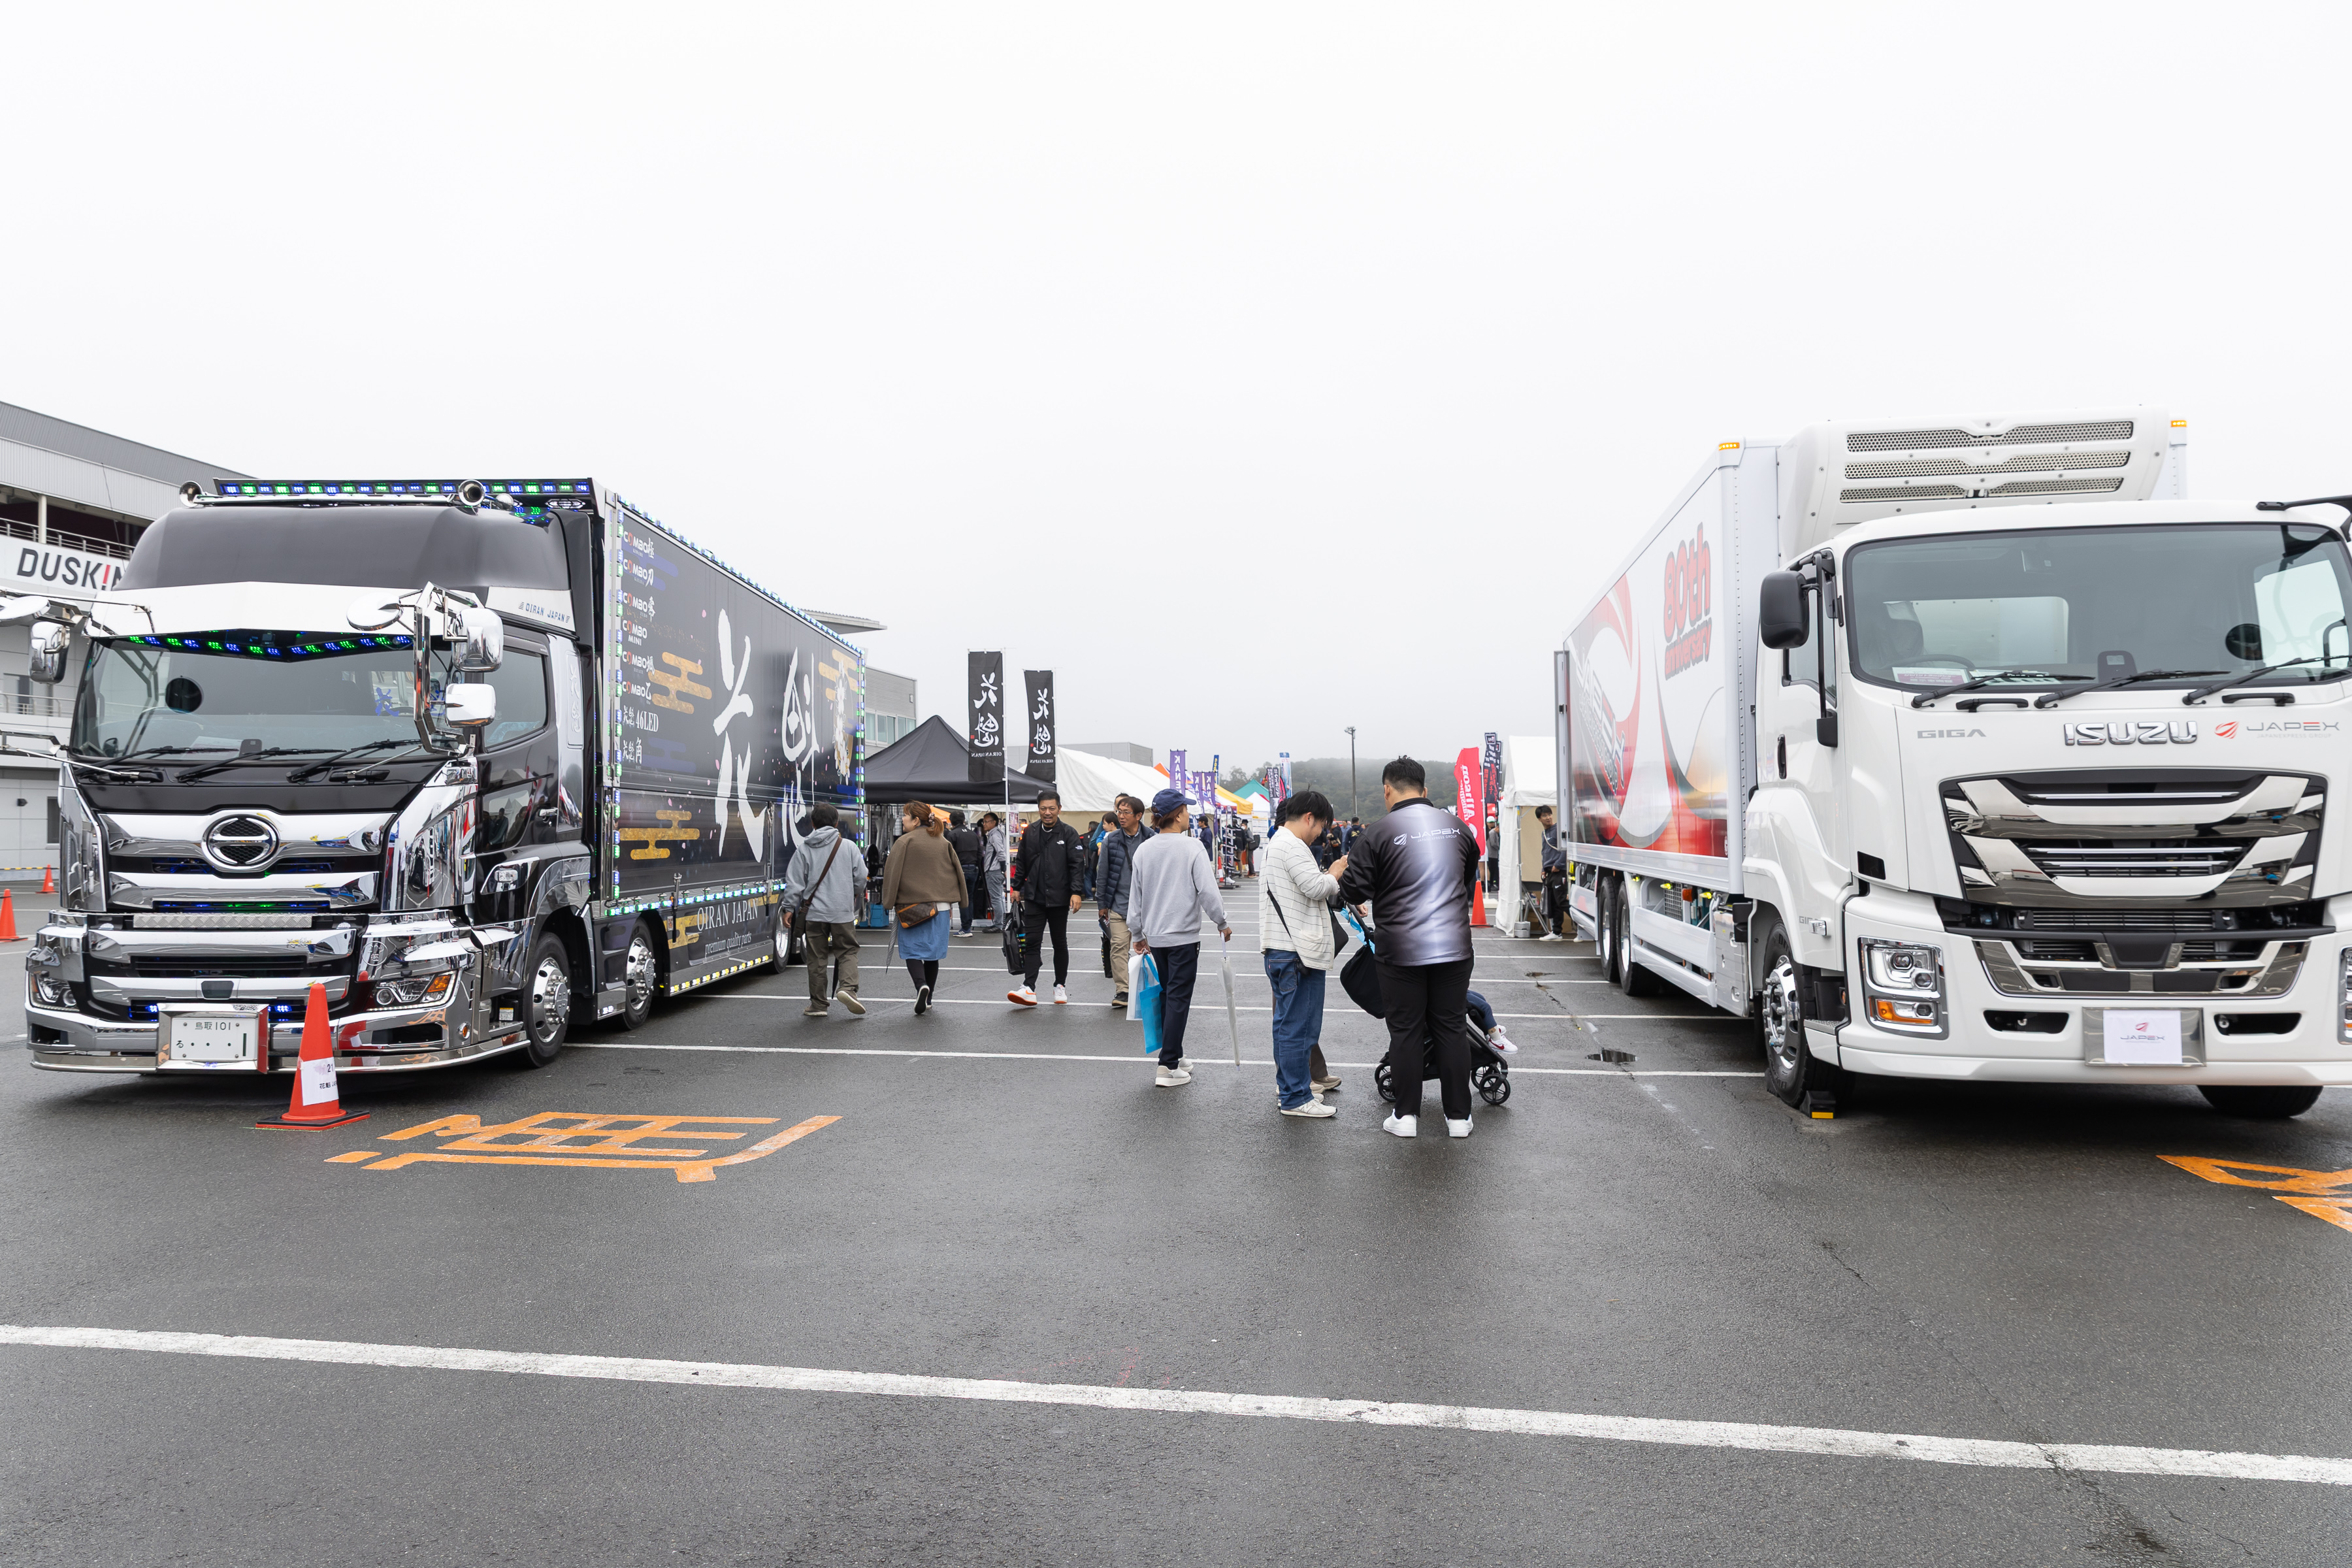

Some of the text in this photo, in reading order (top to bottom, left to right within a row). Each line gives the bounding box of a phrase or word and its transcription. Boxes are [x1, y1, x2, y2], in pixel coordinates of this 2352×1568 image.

[1664, 522, 1710, 644] 80th
[525, 603, 565, 622] OIRAN JAPAN
[623, 620, 647, 639] COMBO
[628, 634, 642, 646] MINI
[1665, 617, 1712, 681] anniversary
[1918, 729, 1987, 738] GIGA
[2064, 721, 2197, 745] ISUZU
[2246, 722, 2340, 731] JAPEX
[1411, 828, 1460, 839] JAPEX
[697, 898, 758, 931] OIRAN JAPAN
[705, 932, 751, 955] premium quality parts
